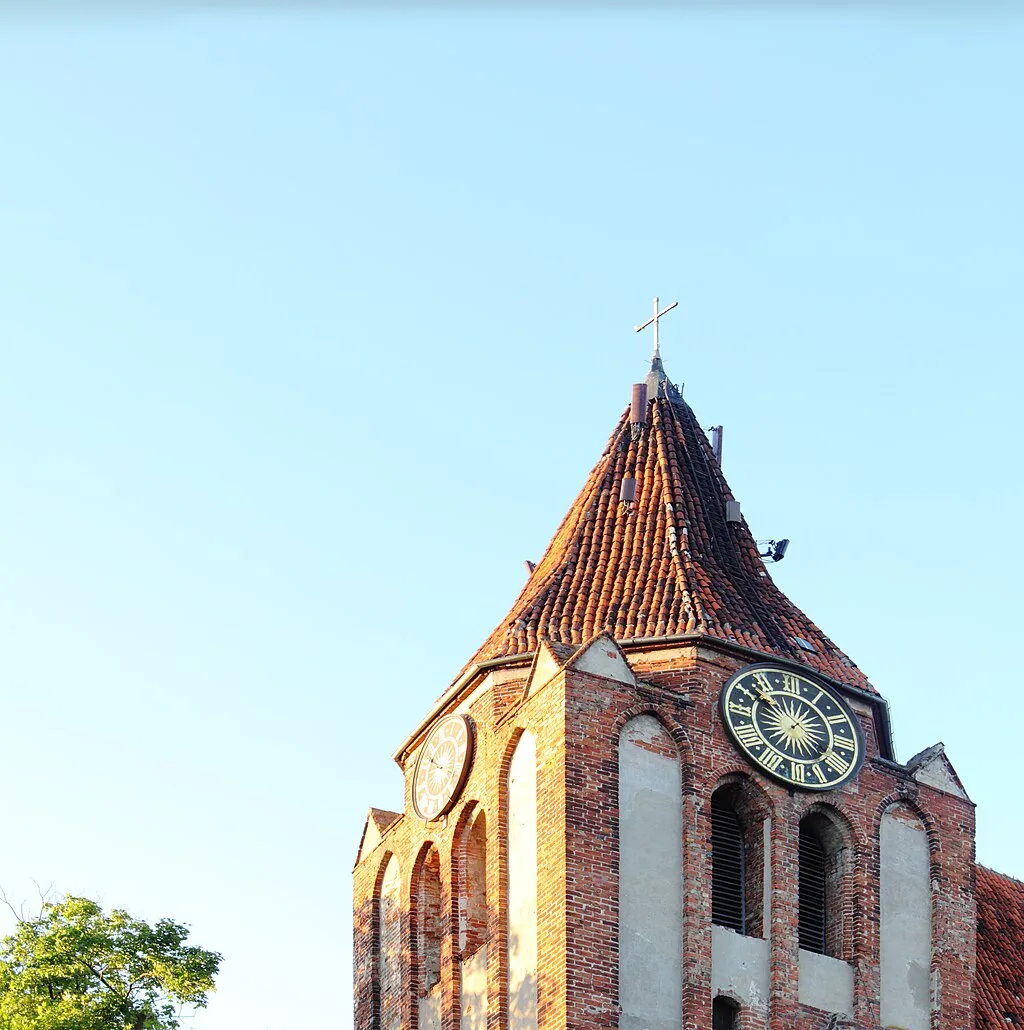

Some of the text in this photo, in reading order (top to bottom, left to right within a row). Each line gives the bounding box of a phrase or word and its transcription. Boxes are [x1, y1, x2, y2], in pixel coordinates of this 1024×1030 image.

[753, 672, 773, 692] XI
[783, 674, 800, 694] XII
[735, 683, 756, 701] X
[811, 691, 824, 705] I
[729, 701, 752, 717] IX
[827, 713, 847, 725] II
[834, 734, 854, 752] III
[791, 762, 805, 783] VI
[825, 752, 850, 775] IIII
[812, 763, 828, 784] V
